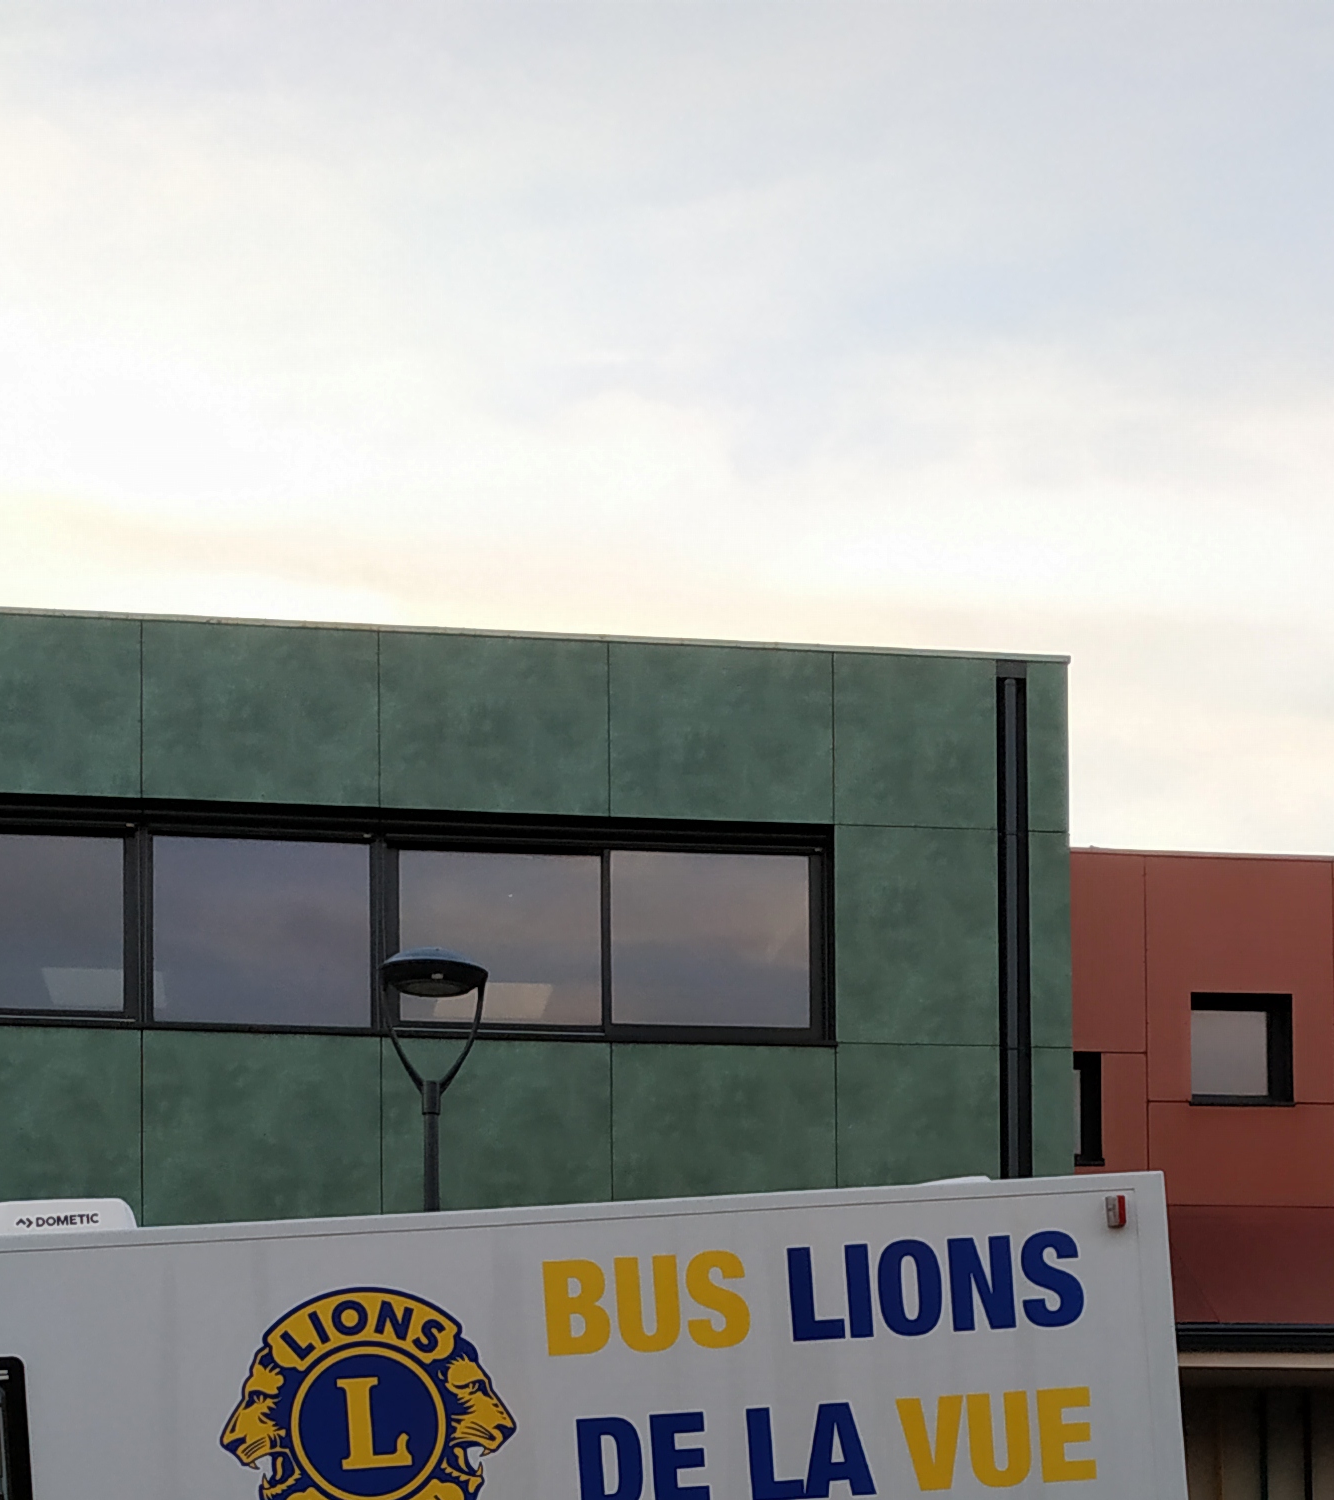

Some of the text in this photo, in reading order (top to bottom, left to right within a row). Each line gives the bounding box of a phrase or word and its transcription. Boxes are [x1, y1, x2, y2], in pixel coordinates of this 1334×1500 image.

[35, 1213, 100, 1228] DOMETIC
[279, 1299, 446, 1362] LIONS
[541, 1230, 1085, 1357] BUS LIONS
[336, 1376, 413, 1470] L
[895, 1386, 1097, 1492] VUE
